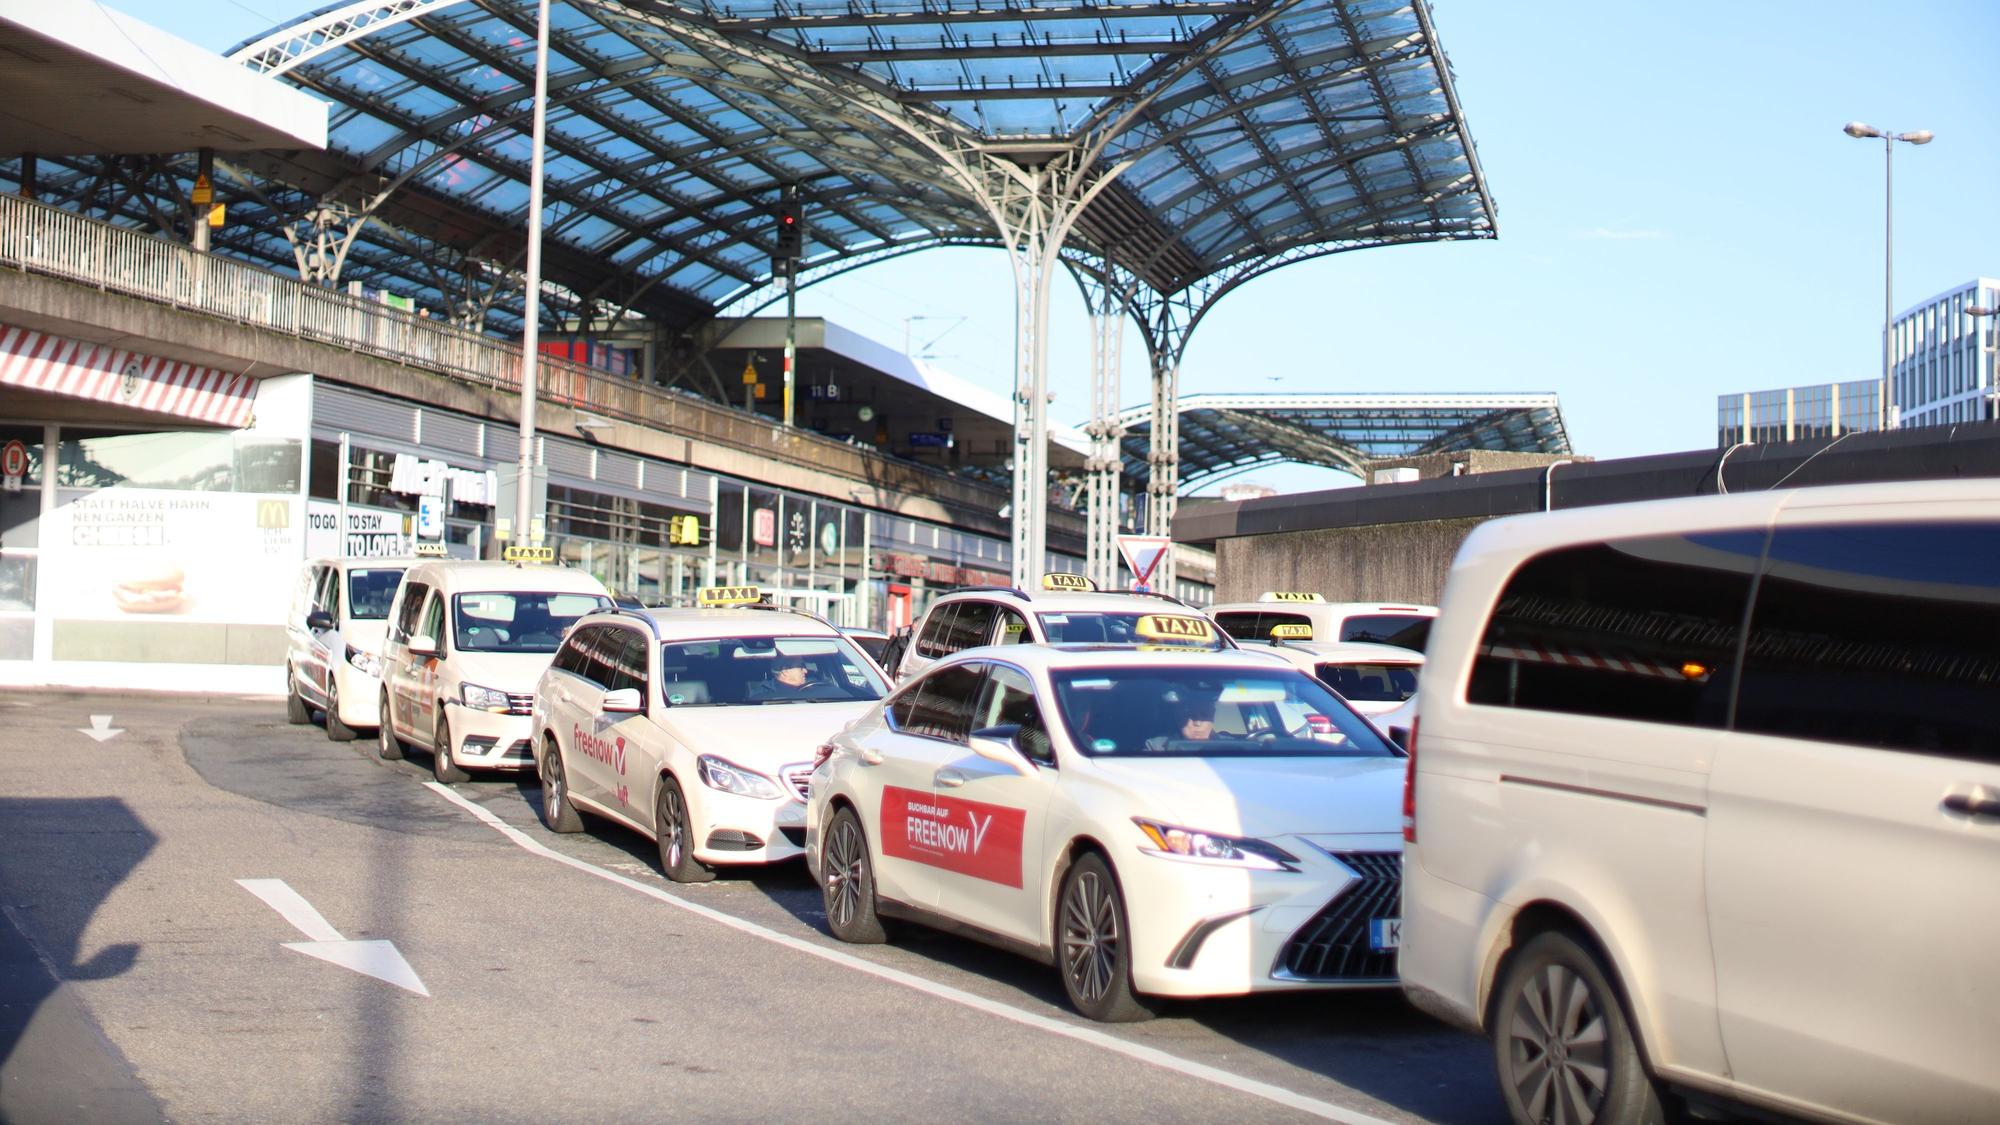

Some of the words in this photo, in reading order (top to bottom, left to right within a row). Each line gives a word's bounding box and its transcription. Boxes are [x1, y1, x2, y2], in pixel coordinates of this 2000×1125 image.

[72, 499, 115, 510] STATT
[120, 499, 166, 510] HALVE
[72, 512, 101, 522] NEN
[105, 512, 164, 522] GANZEN
[309, 514, 321, 529] TO
[348, 515, 360, 529] TO
[362, 515, 382, 529] STAY
[347, 533, 366, 556] TO
[514, 547, 546, 558] TAXI
[1053, 575, 1084, 586] TAXI
[711, 588, 752, 600] TAXI
[1276, 592, 1312, 600] TAXI
[1156, 617, 1204, 635] TAXI
[1283, 625, 1308, 635] TAXI
[908, 802, 936, 815] BUCHBAR
[936, 807, 949, 818] AUF
[907, 816, 969, 854] FREENOW
[1390, 921, 1402, 945] K
